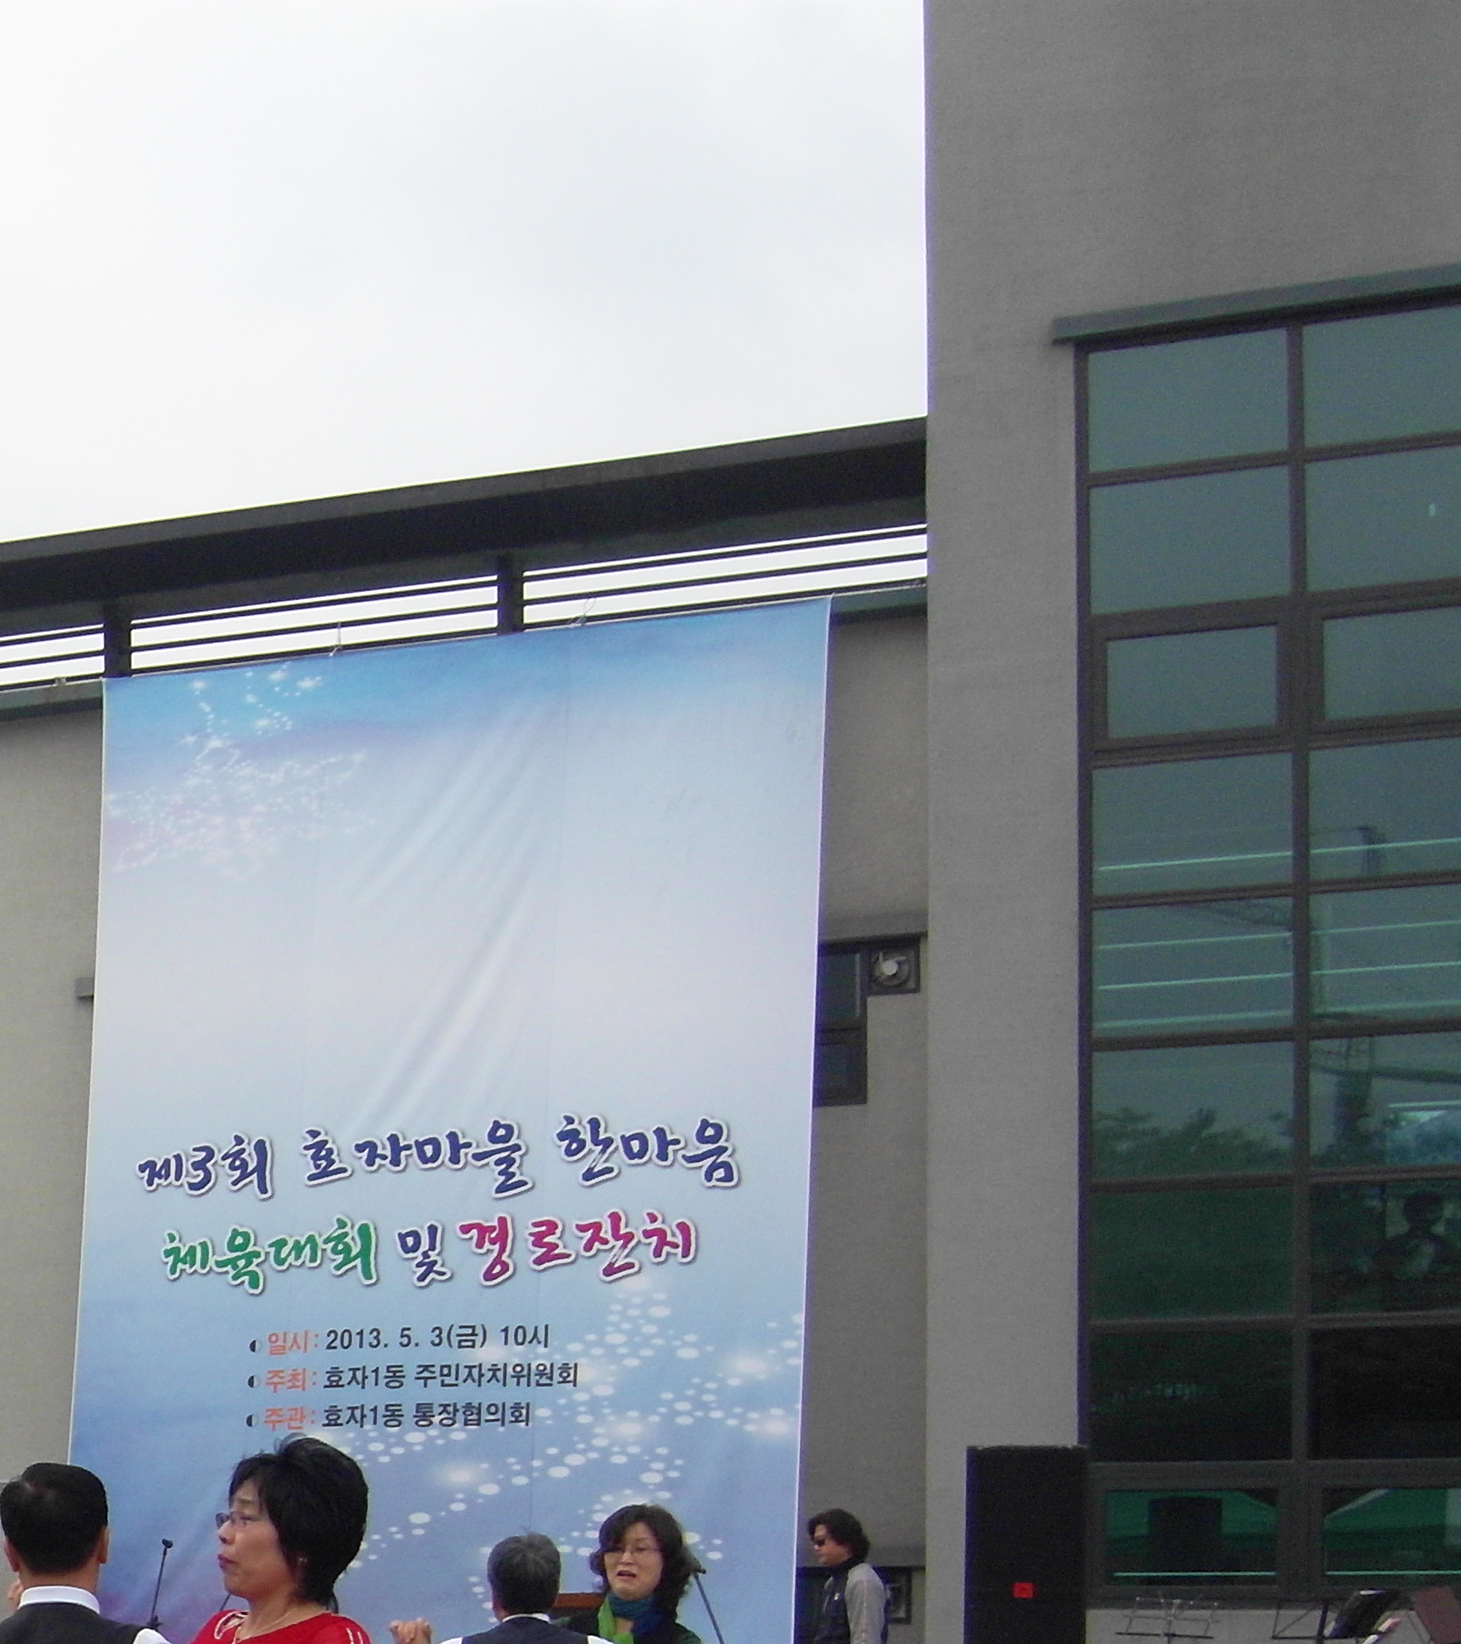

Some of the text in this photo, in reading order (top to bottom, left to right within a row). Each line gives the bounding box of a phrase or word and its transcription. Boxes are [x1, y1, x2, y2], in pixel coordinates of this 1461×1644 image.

[137, 1114, 736, 1195] 제3회 효자마을 한마음
[162, 1211, 692, 1291] 체육대회 및 경로잔치
[326, 1327, 389, 1350] 2013.
[399, 1326, 420, 1348] 5.
[430, 1323, 487, 1350] 3(금)
[500, 1323, 550, 1348] 10시
[323, 1364, 406, 1389] 효자1동
[414, 1361, 579, 1388] 주민자치위원회
[321, 1402, 404, 1428] 효자1동
[413, 1400, 531, 1428] 통장협의회
